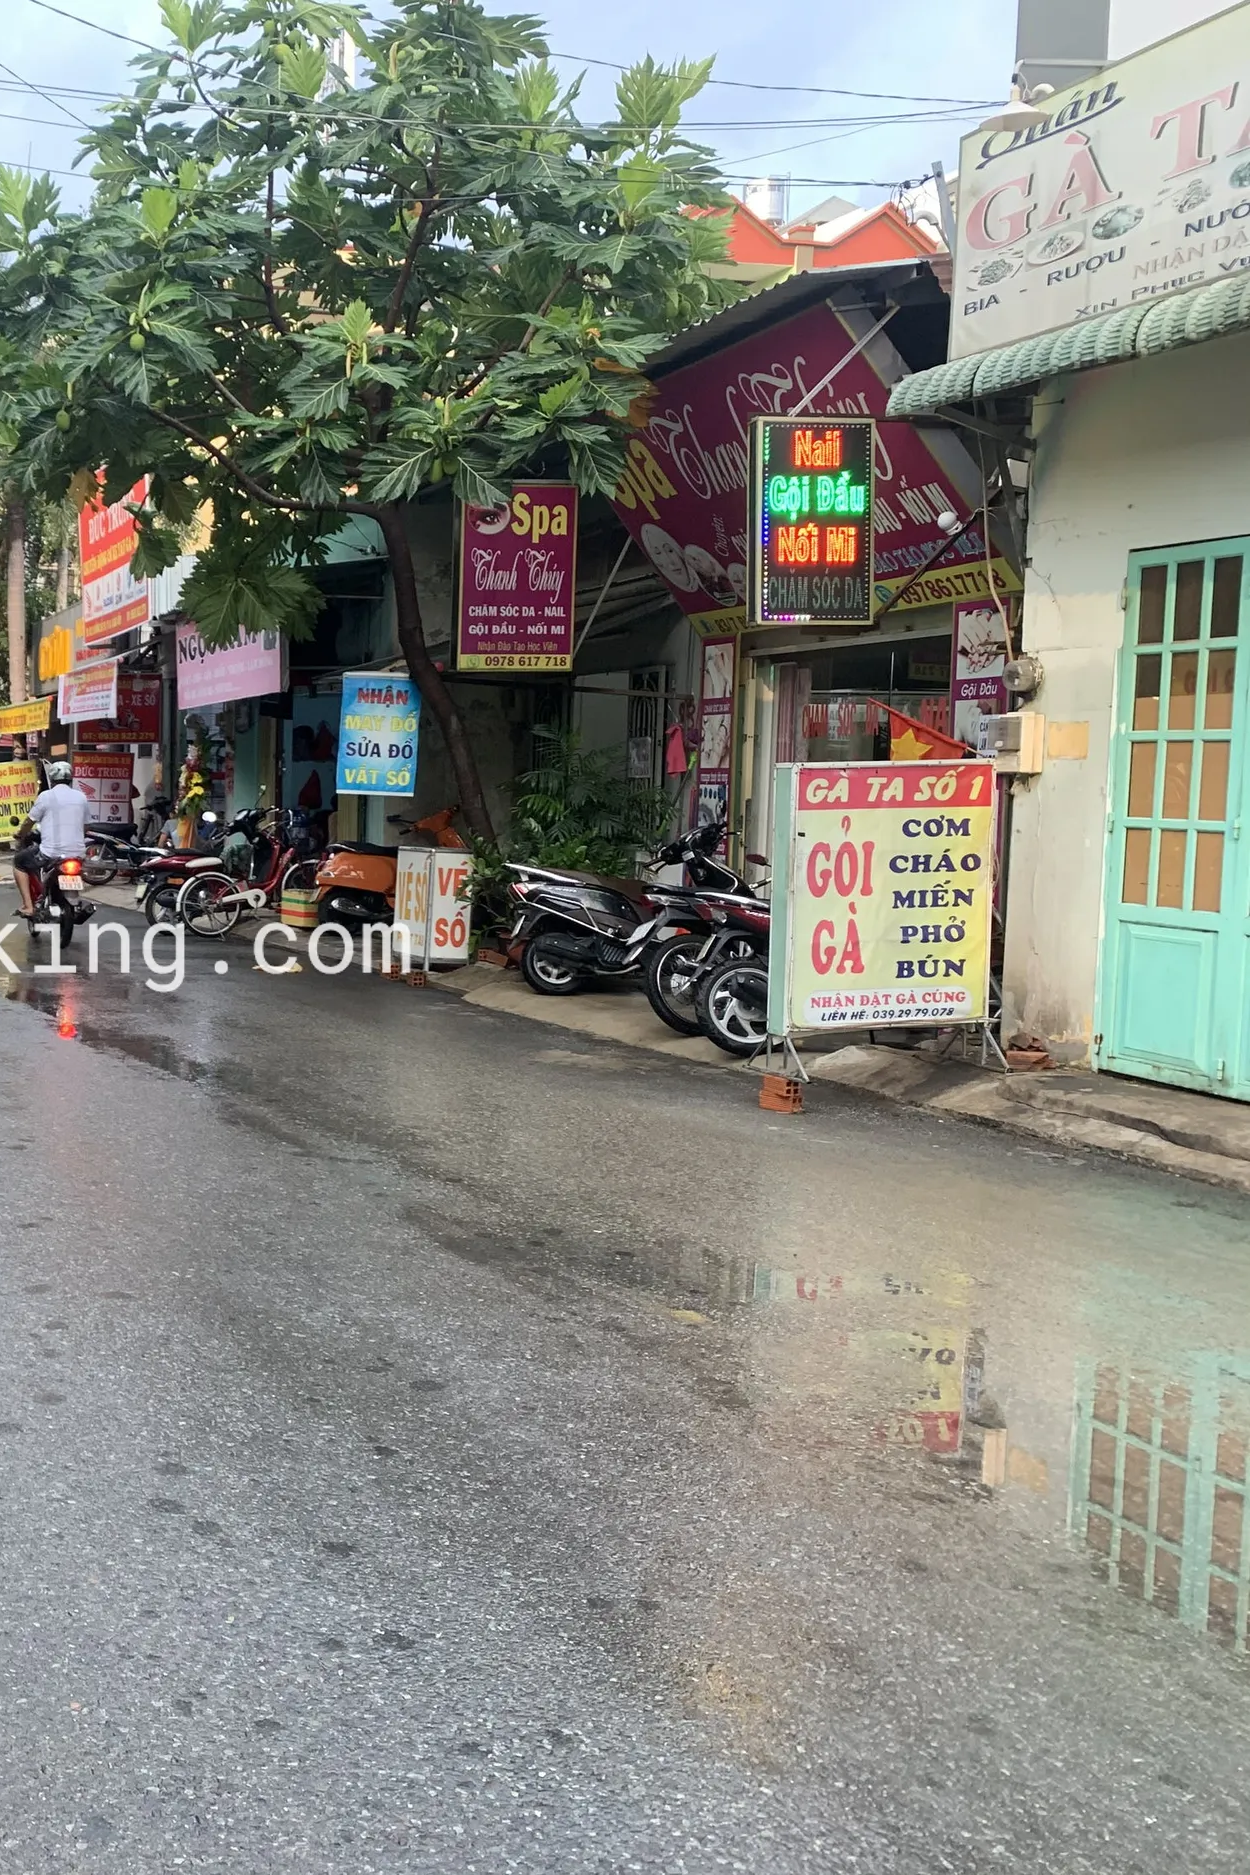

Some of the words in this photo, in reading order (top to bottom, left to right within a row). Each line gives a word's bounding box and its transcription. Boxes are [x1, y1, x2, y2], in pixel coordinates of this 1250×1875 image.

[965, 130, 1123, 251] GÀ
[1150, 81, 1250, 181] T
[963, 294, 999, 316] BIA
[1047, 246, 1127, 286] RƯỢU
[1075, 298, 1118, 320] XIN
[794, 430, 841, 467] Nail
[769, 475, 810, 521] Gội
[511, 492, 568, 544] Spa
[778, 523, 818, 562] Nối
[826, 527, 855, 562] Mi
[471, 547, 522, 591] Thanh
[768, 568, 808, 608] CHĂM
[812, 568, 841, 609] SÓC
[844, 577, 863, 609] DA
[500, 602, 519, 617] SÓC
[522, 607, 535, 617] DA
[544, 607, 566, 617] NAIL
[469, 623, 489, 637] GỘI
[492, 620, 516, 635] ĐẦU
[527, 621, 547, 635] NỐI
[551, 625, 565, 635] MI
[485, 656, 515, 667] 0978
[518, 656, 540, 667] 617
[545, 656, 567, 667] 718
[131, 694, 143, 706] XE
[356, 684, 409, 708] NHẬN
[961, 683, 976, 699] Gội
[344, 714, 385, 731] MAY
[346, 736, 381, 758] SỬA
[388, 738, 413, 760] ĐỒ
[74, 765, 94, 777] ĐỨC
[97, 767, 129, 778] TRUNG
[386, 763, 411, 787] SỔ
[14, 778, 35, 797] TẤM
[806, 769, 850, 804] GÀ
[866, 776, 904, 802] TA
[914, 766, 966, 801] SỐ
[968, 776, 984, 801] 1
[901, 815, 971, 838] CƠM
[806, 815, 875, 898] GỎI
[889, 848, 982, 874] CHÁO
[399, 862, 413, 920] VÉ
[438, 861, 469, 897] VÉ
[892, 880, 975, 909] MIẾN
[434, 904, 470, 948] SỐ
[811, 901, 865, 975] GÀ
[900, 915, 966, 944] PHỞ
[896, 954, 967, 979] BÚN
[810, 991, 855, 1010] NHẬN
[860, 992, 891, 1007] ĐẶT
[896, 990, 920, 1005] GÀ
[922, 988, 967, 1004] CÚNG
[821, 1008, 848, 1022] LIÊN
[872, 1007, 955, 1020] 039.29.79.078
